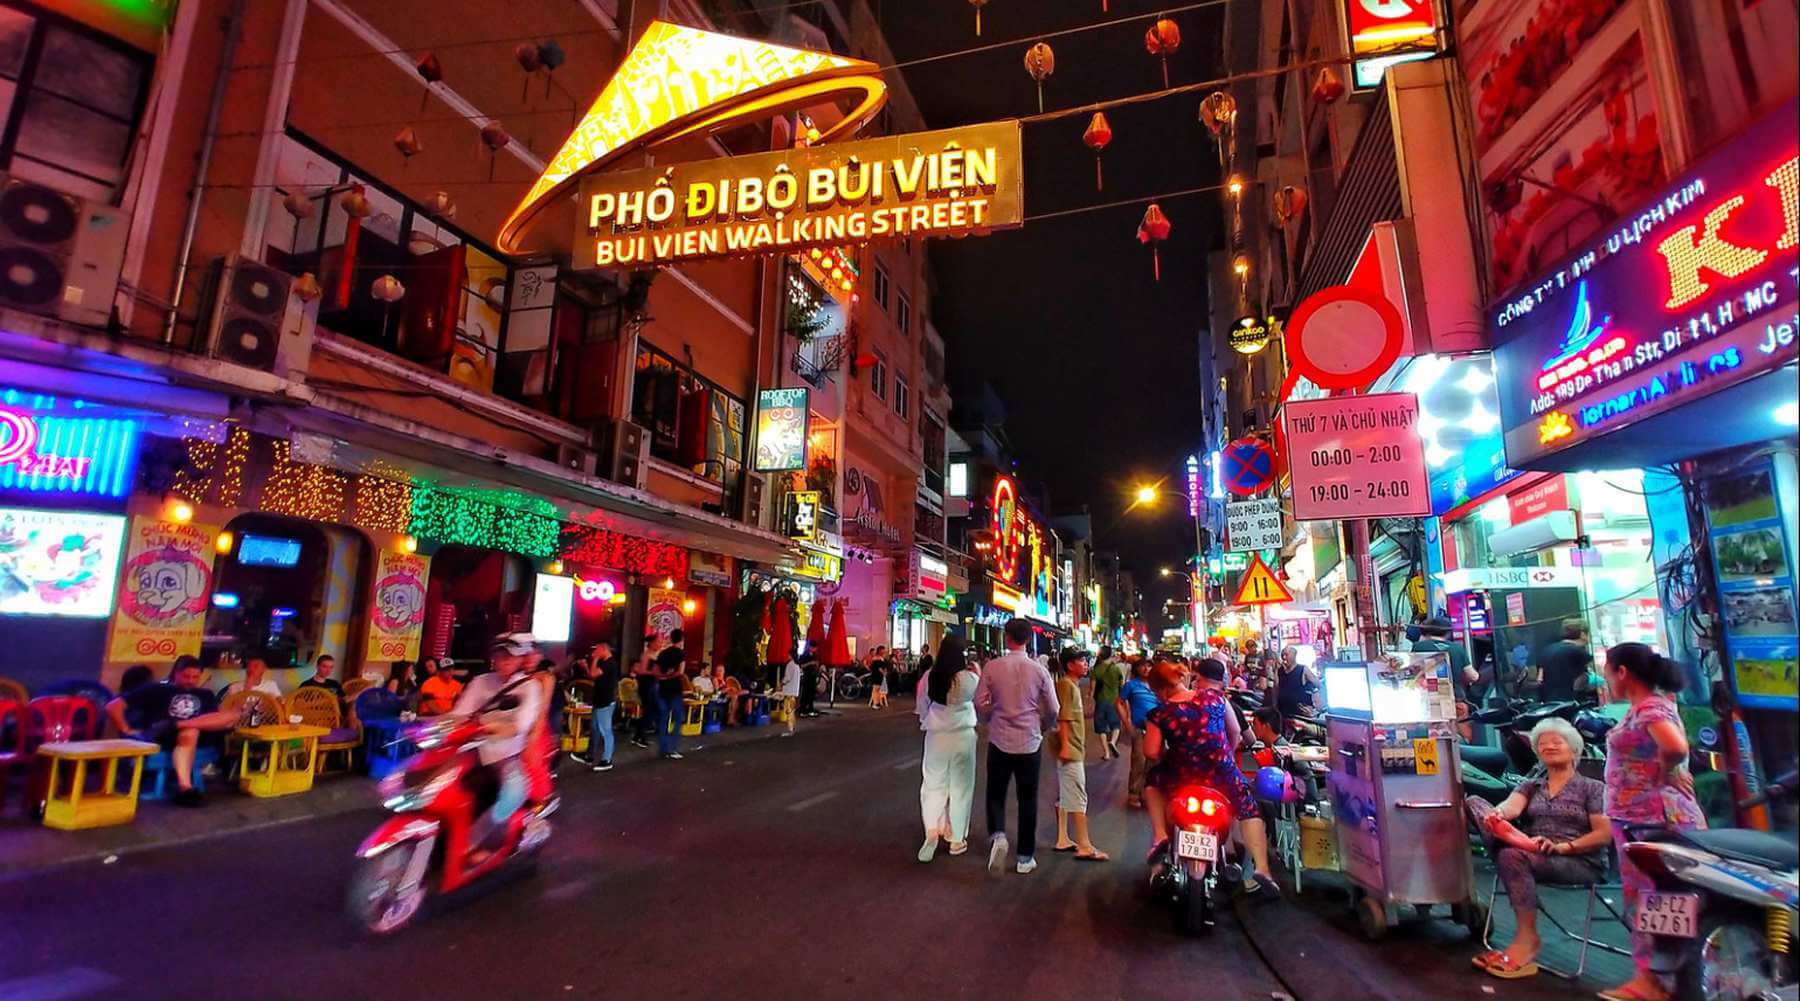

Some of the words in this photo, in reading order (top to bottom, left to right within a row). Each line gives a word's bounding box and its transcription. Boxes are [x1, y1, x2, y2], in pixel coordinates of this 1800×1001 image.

[590, 167, 675, 228] PHỐ
[685, 180, 730, 218] ĐI
[737, 163, 797, 221] BỘ
[808, 155, 883, 204] BÙI
[893, 141, 997, 199] VIỆN
[596, 237, 645, 265] BUI
[653, 228, 718, 259] VIEN
[725, 213, 866, 250] WALKING
[871, 200, 988, 235] STREET
[1498, 295, 1534, 326] CÔNG
[1622, 204, 1665, 245] LỊCH
[1666, 179, 1705, 216] KIM
[760, 388, 806, 401] ROOFTOP
[1530, 392, 1555, 415] Add:
[1292, 412, 1316, 434] THỨ
[1319, 416, 1328, 432] 7
[1331, 410, 1348, 432] VÀ
[1351, 407, 1377, 430] CHỦ
[1381, 405, 1414, 429] NHẬT
[1311, 448, 1352, 467] 00:00
[1369, 445, 1401, 464] 2:00
[1310, 484, 1349, 502] 19:00
[1367, 480, 1409, 499] 24:00
[1230, 520, 1249, 533] 9:00
[1488, 571, 1529, 584] HSBC
